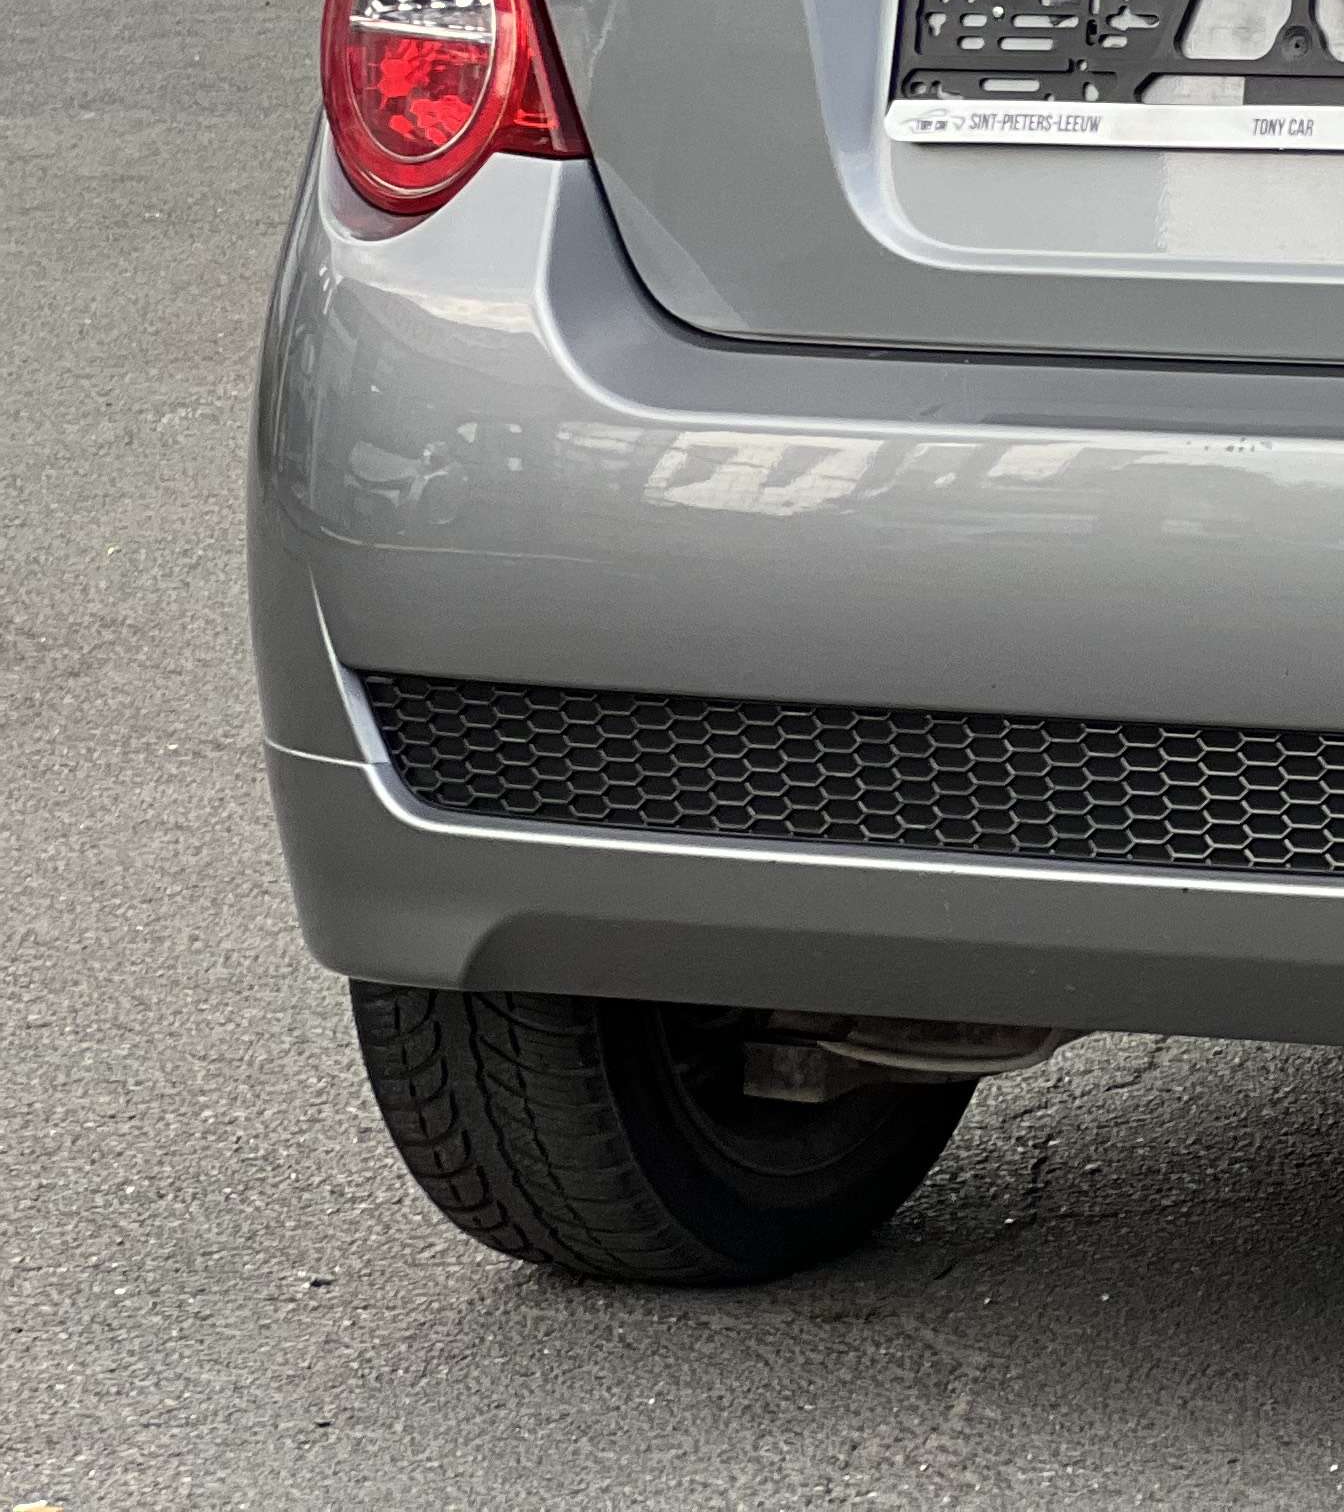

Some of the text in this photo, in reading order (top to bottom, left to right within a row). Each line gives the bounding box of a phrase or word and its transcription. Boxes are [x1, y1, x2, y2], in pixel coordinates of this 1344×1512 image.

[969, 113, 1102, 132] SINT-PIETERS-LEEUW
[1253, 118, 1314, 136] TONY CAR
